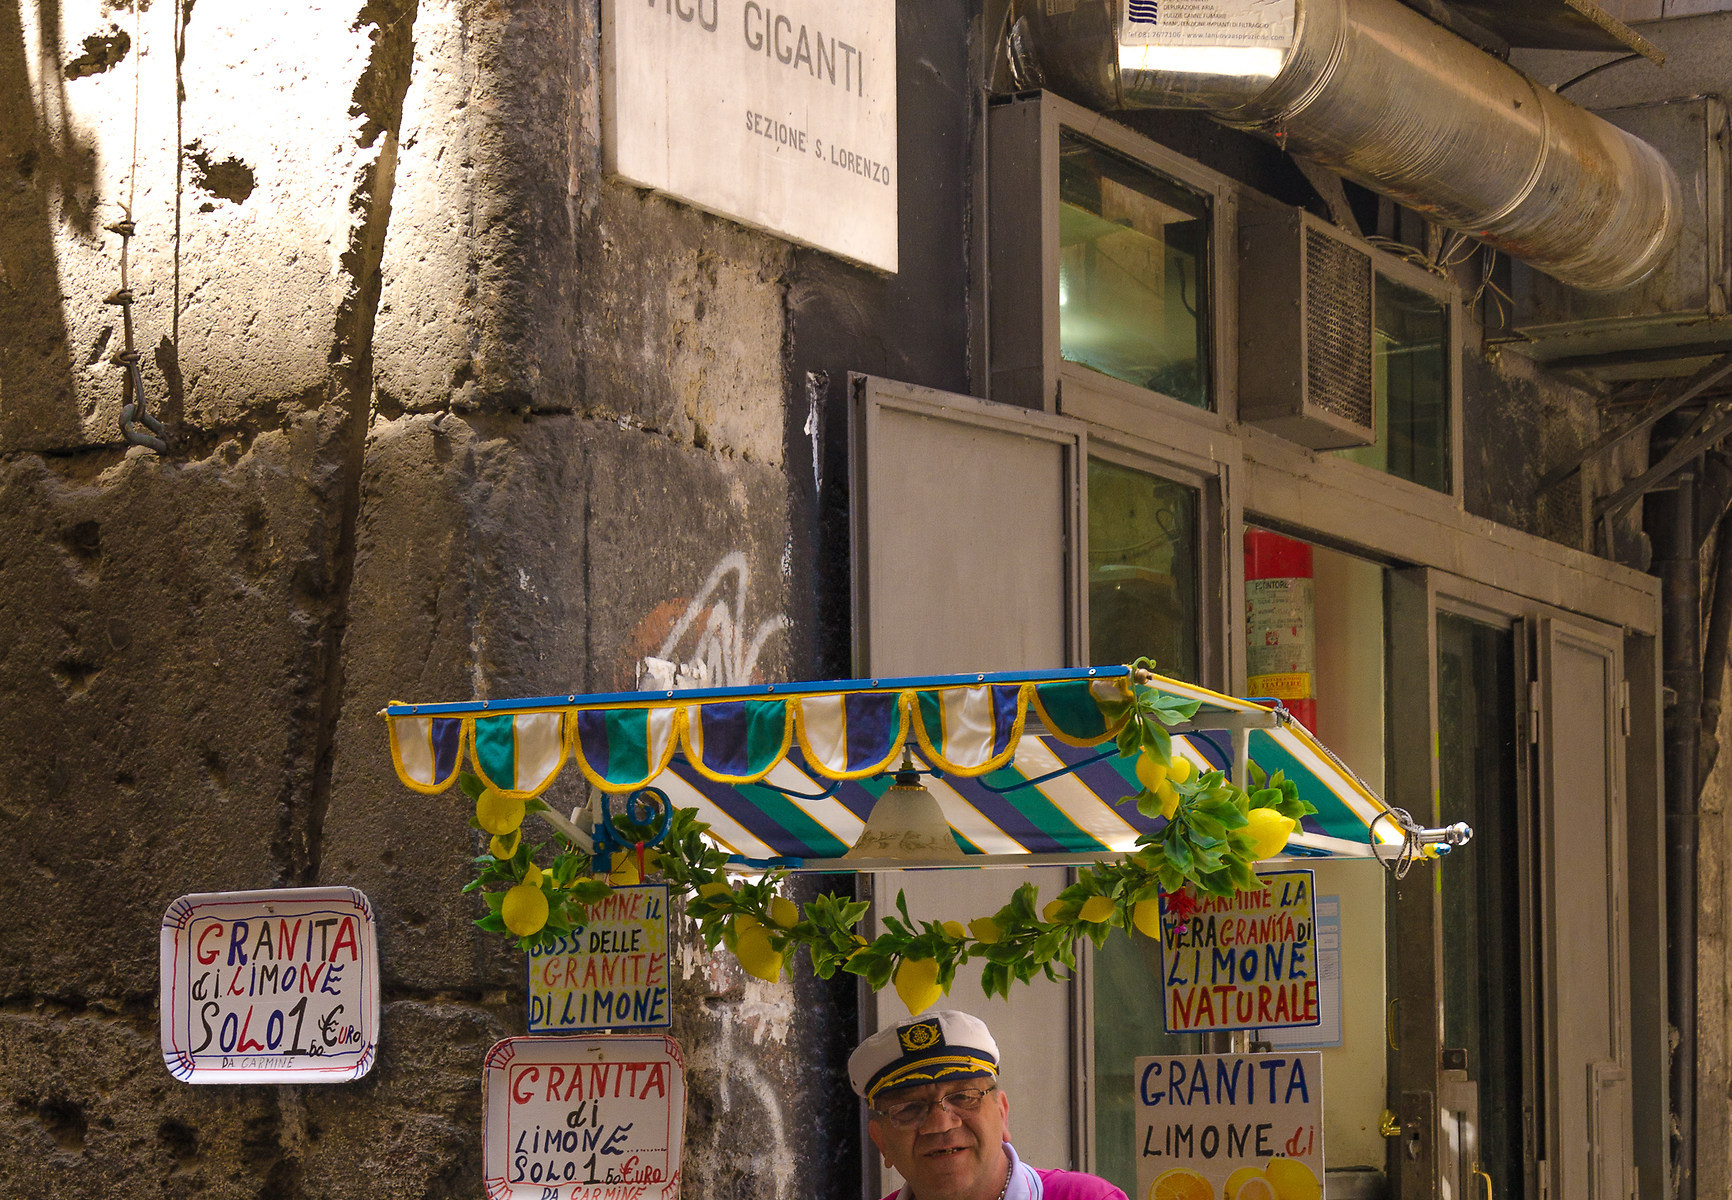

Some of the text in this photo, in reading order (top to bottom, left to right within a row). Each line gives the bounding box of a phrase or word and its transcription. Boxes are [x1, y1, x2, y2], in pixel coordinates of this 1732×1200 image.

[743, 1, 863, 98] GIGANTI
[745, 110, 890, 187] SEZIONE S. LORENZO
[1280, 880, 1308, 908] LA
[197, 916, 358, 966] GRANITA
[589, 929, 642, 954] DELLE
[1219, 911, 1296, 947] GRANITA
[227, 961, 344, 997] LIMONE
[543, 953, 667, 989] GRANITE
[1167, 941, 1308, 987] LIMONE
[560, 987, 667, 1025] LIMONE
[1172, 980, 1318, 1030] NATURALE
[222, 1057, 295, 1069] DA CARMINE
[1140, 1058, 1310, 1106] GRANITA
[512, 1063, 666, 1105] GRANITA
[566, 1099, 599, 1128] di
